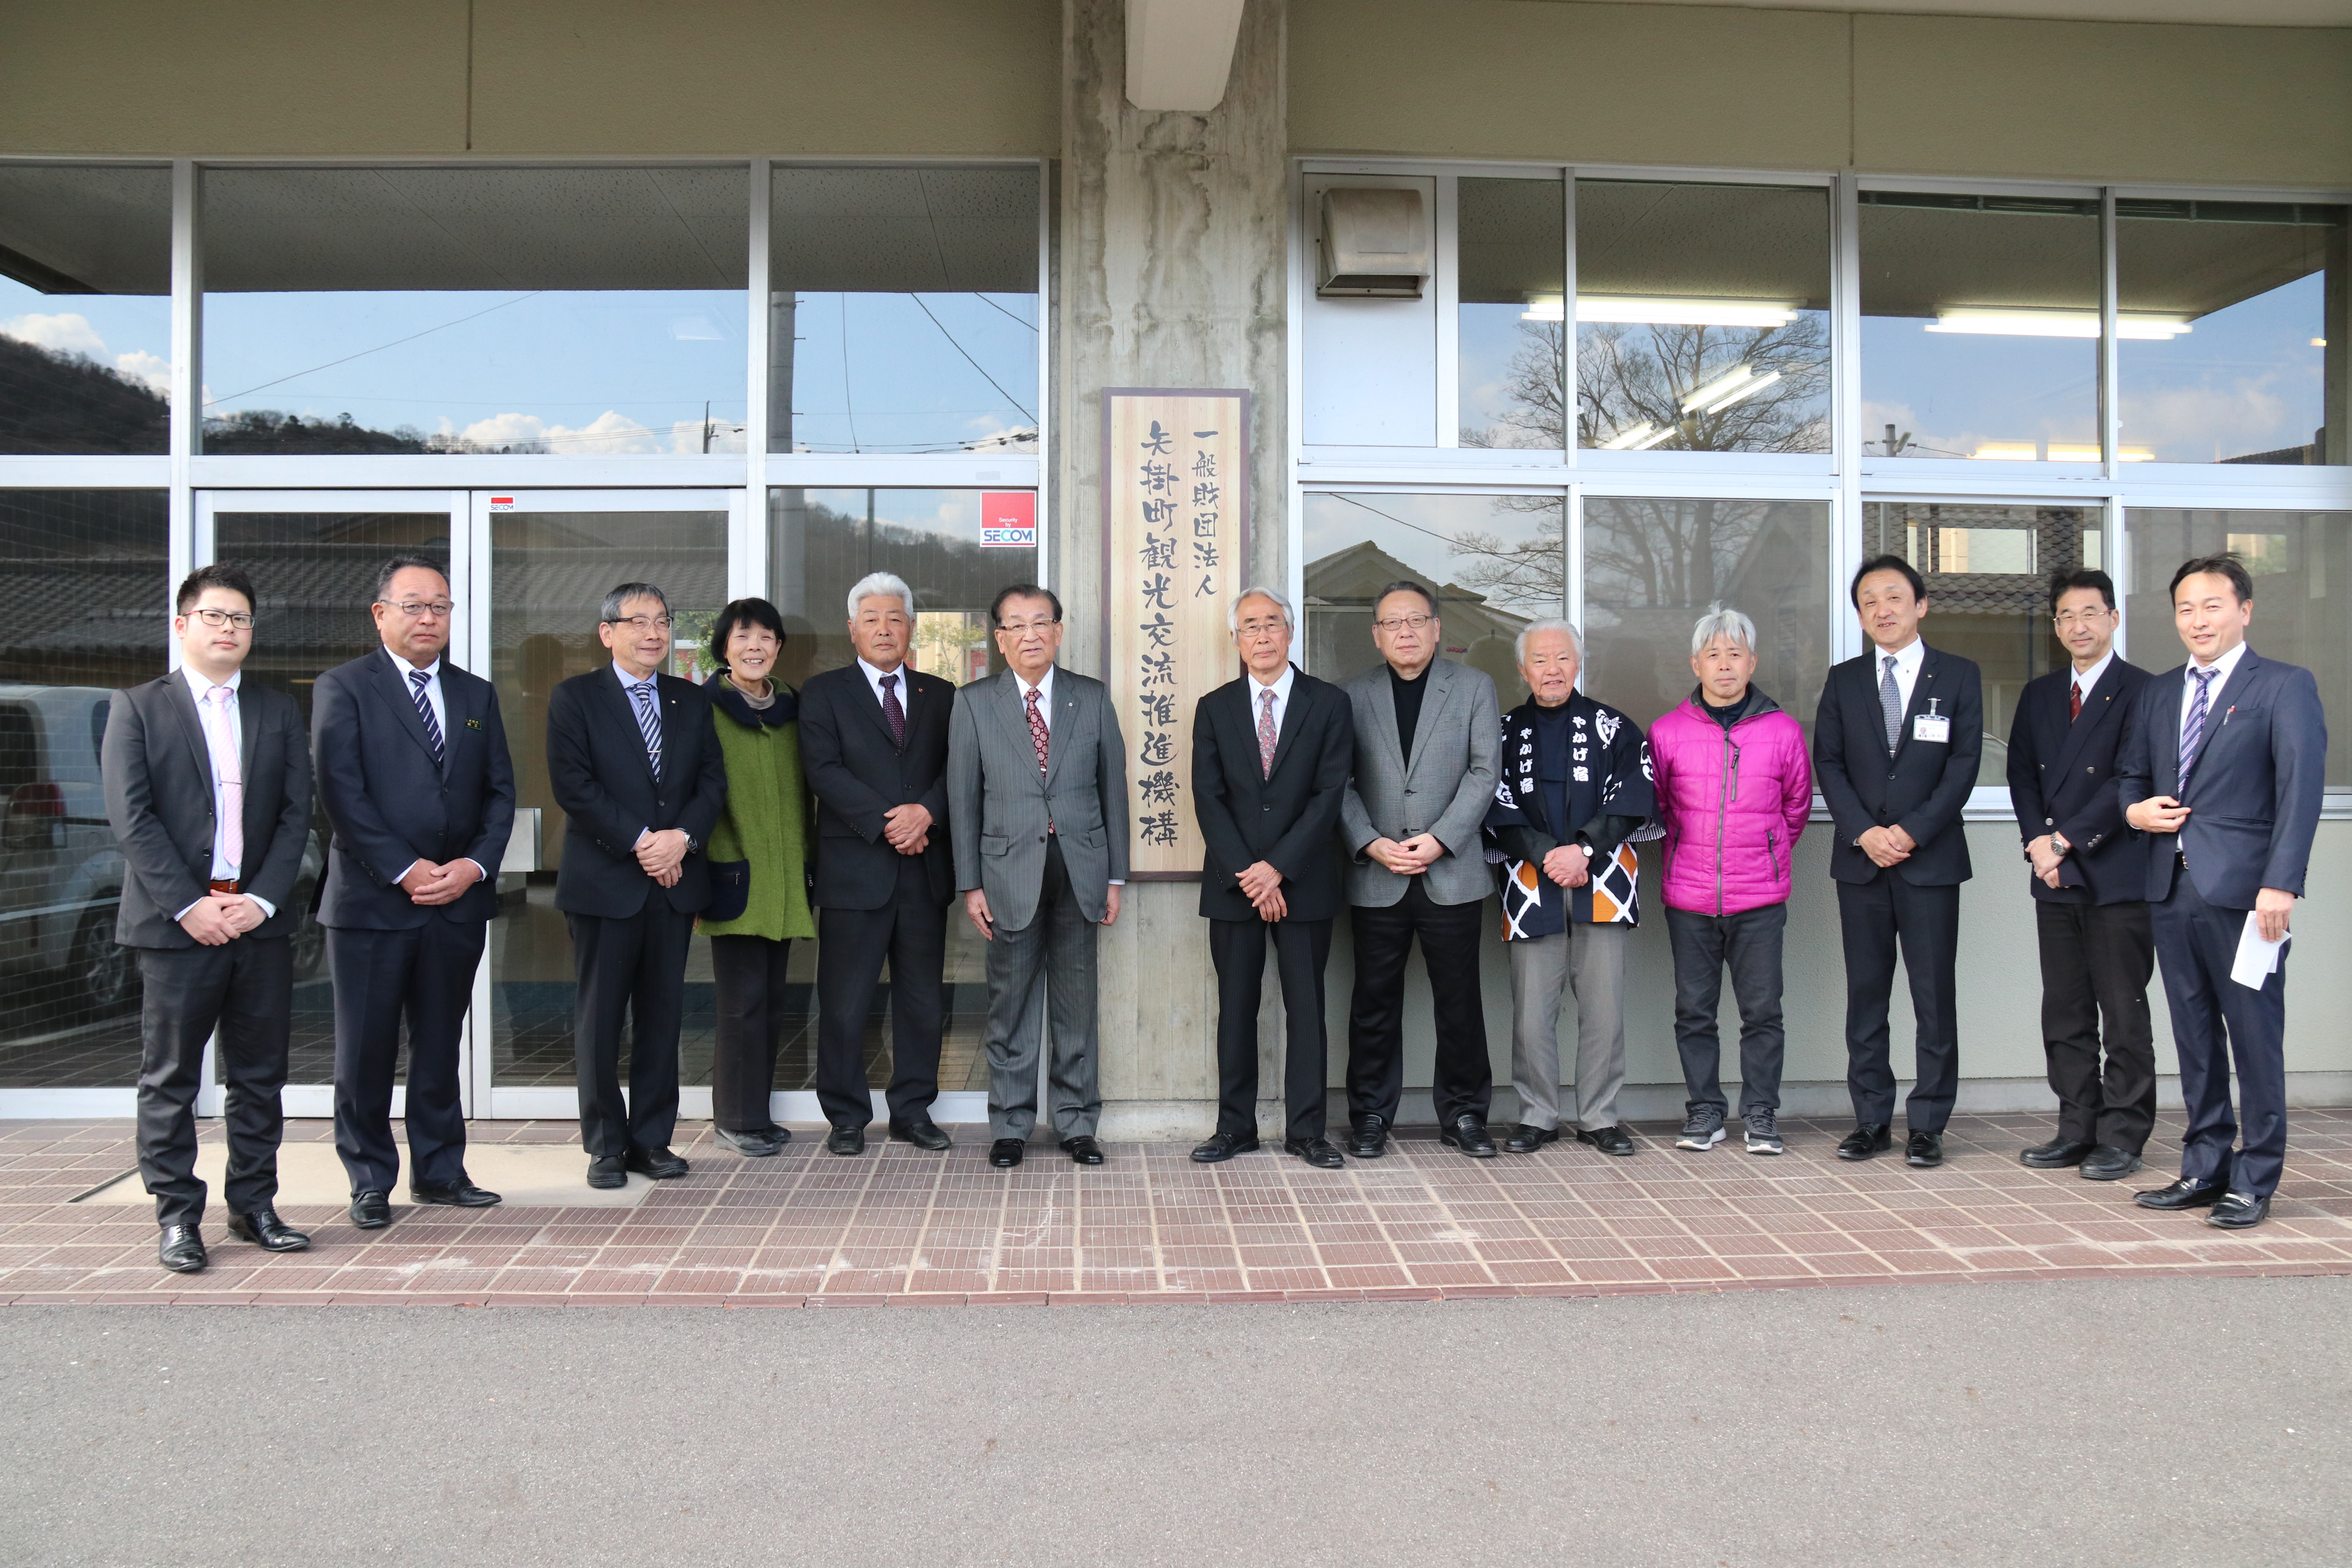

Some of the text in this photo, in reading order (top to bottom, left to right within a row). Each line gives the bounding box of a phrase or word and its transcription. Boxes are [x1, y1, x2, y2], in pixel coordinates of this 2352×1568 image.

[984, 530, 1032, 541] SECOM
[1192, 430, 1219, 597] 一般財団法人
[1138, 421, 1180, 848] 矢掛町観光交流推進機構
[1519, 728, 1534, 794] やかげ宿
[1572, 716, 1588, 782] やかげ宿
